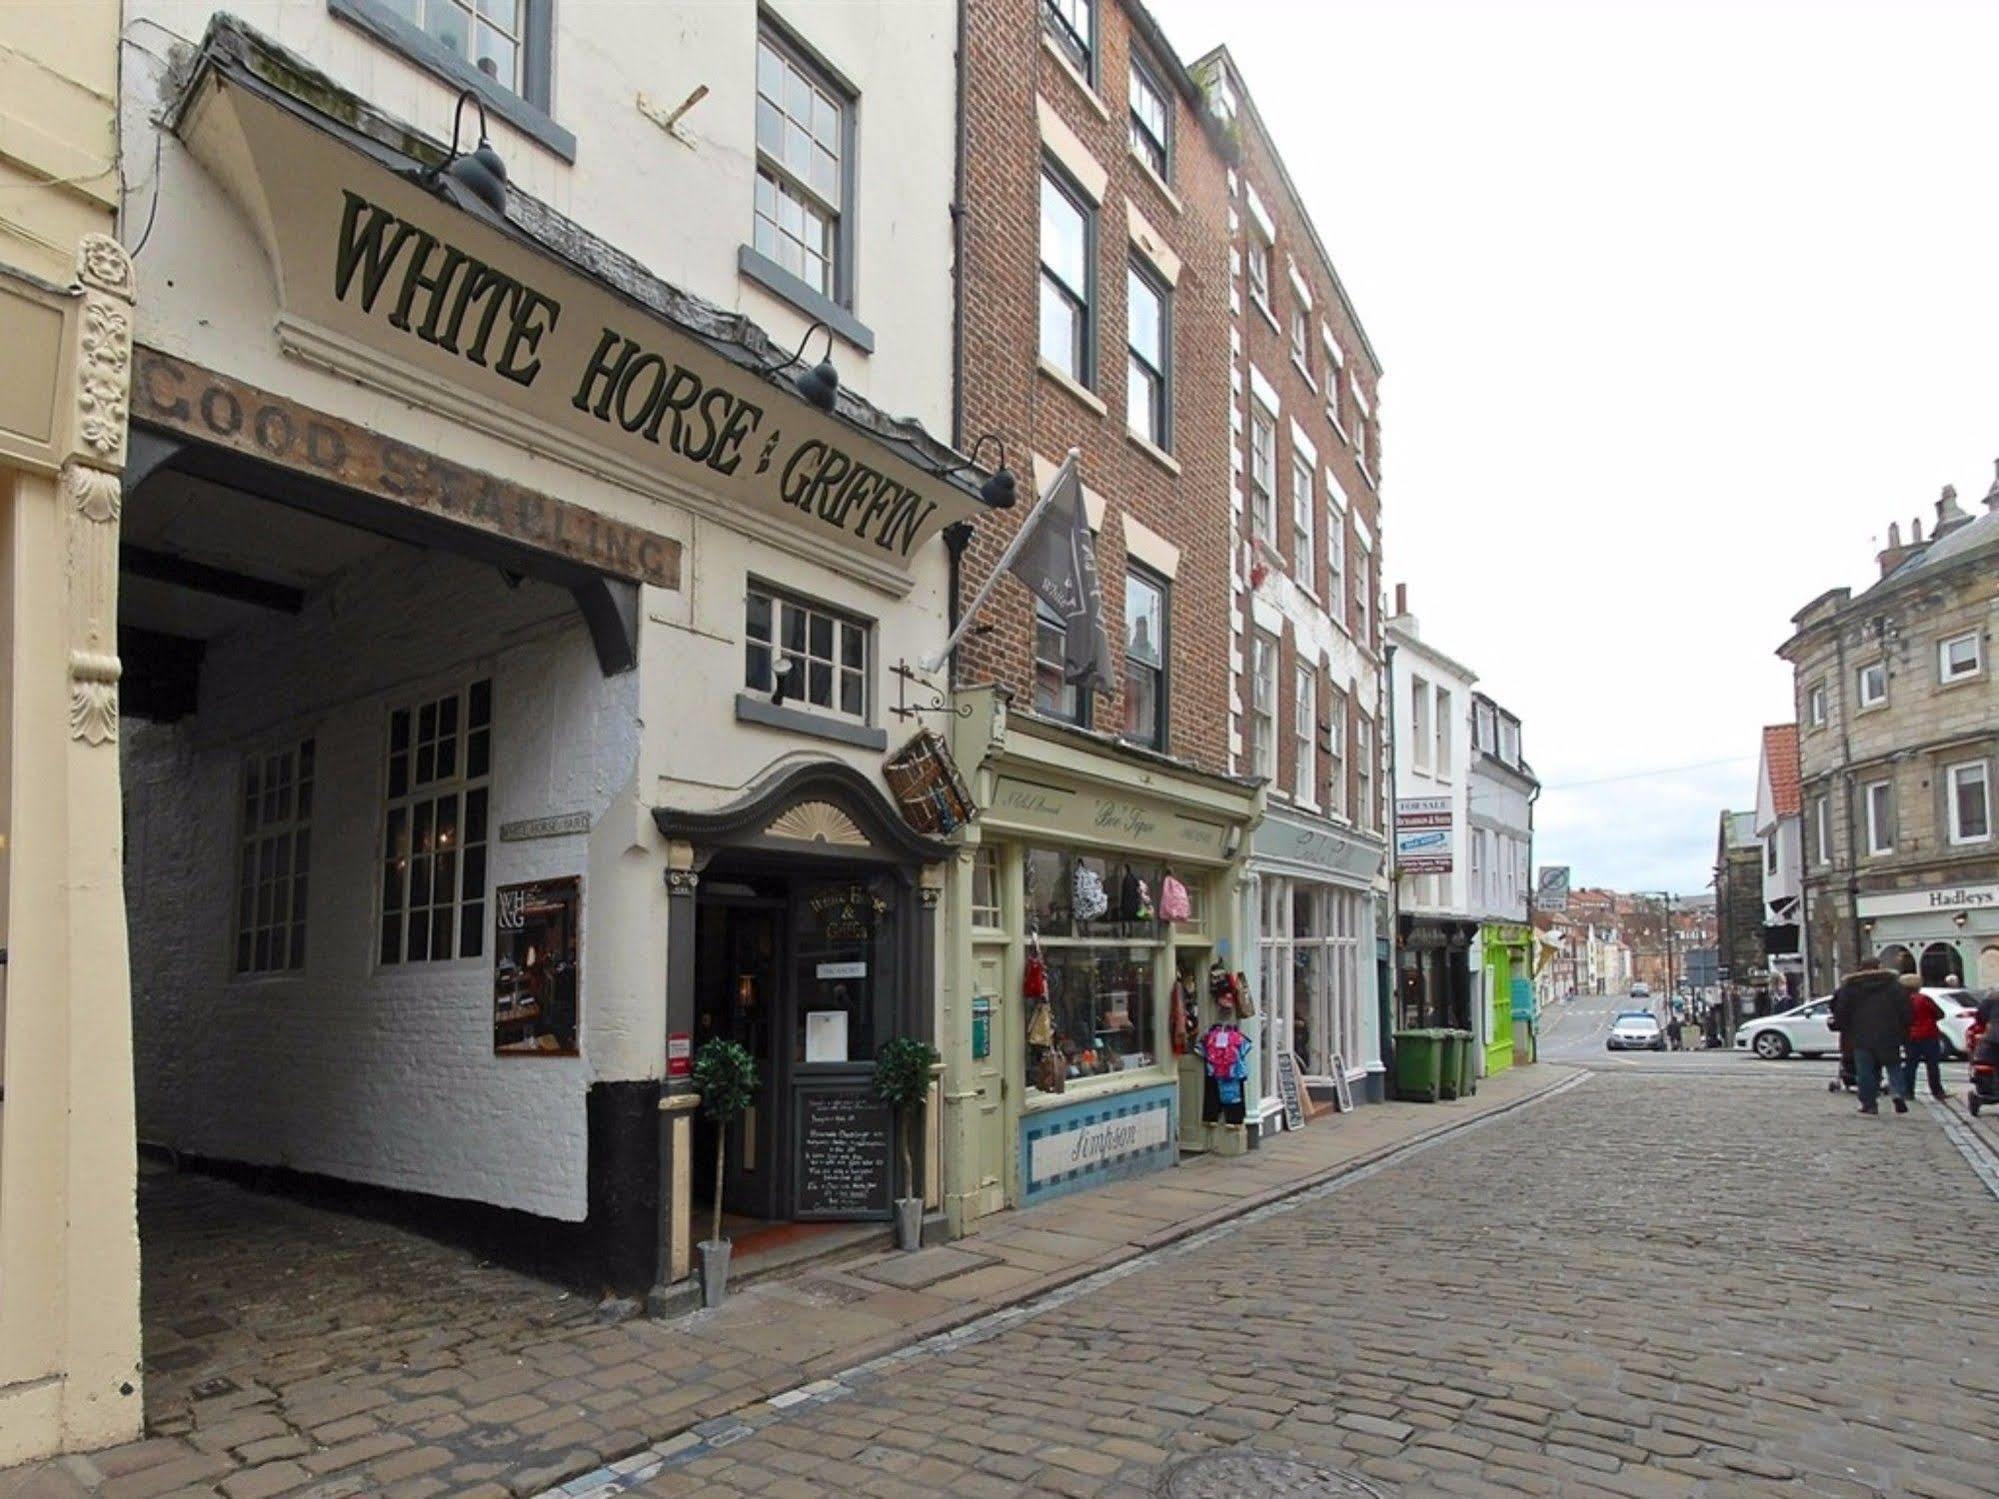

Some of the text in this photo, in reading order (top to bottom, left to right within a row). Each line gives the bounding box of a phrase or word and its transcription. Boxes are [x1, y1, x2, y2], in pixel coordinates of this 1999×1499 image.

[137, 356, 347, 472] GOOD
[334, 189, 561, 388] WHITE
[571, 327, 764, 476] HORSE
[779, 438, 938, 557] GRIFFIN
[1929, 889, 1993, 907] Hadleys
